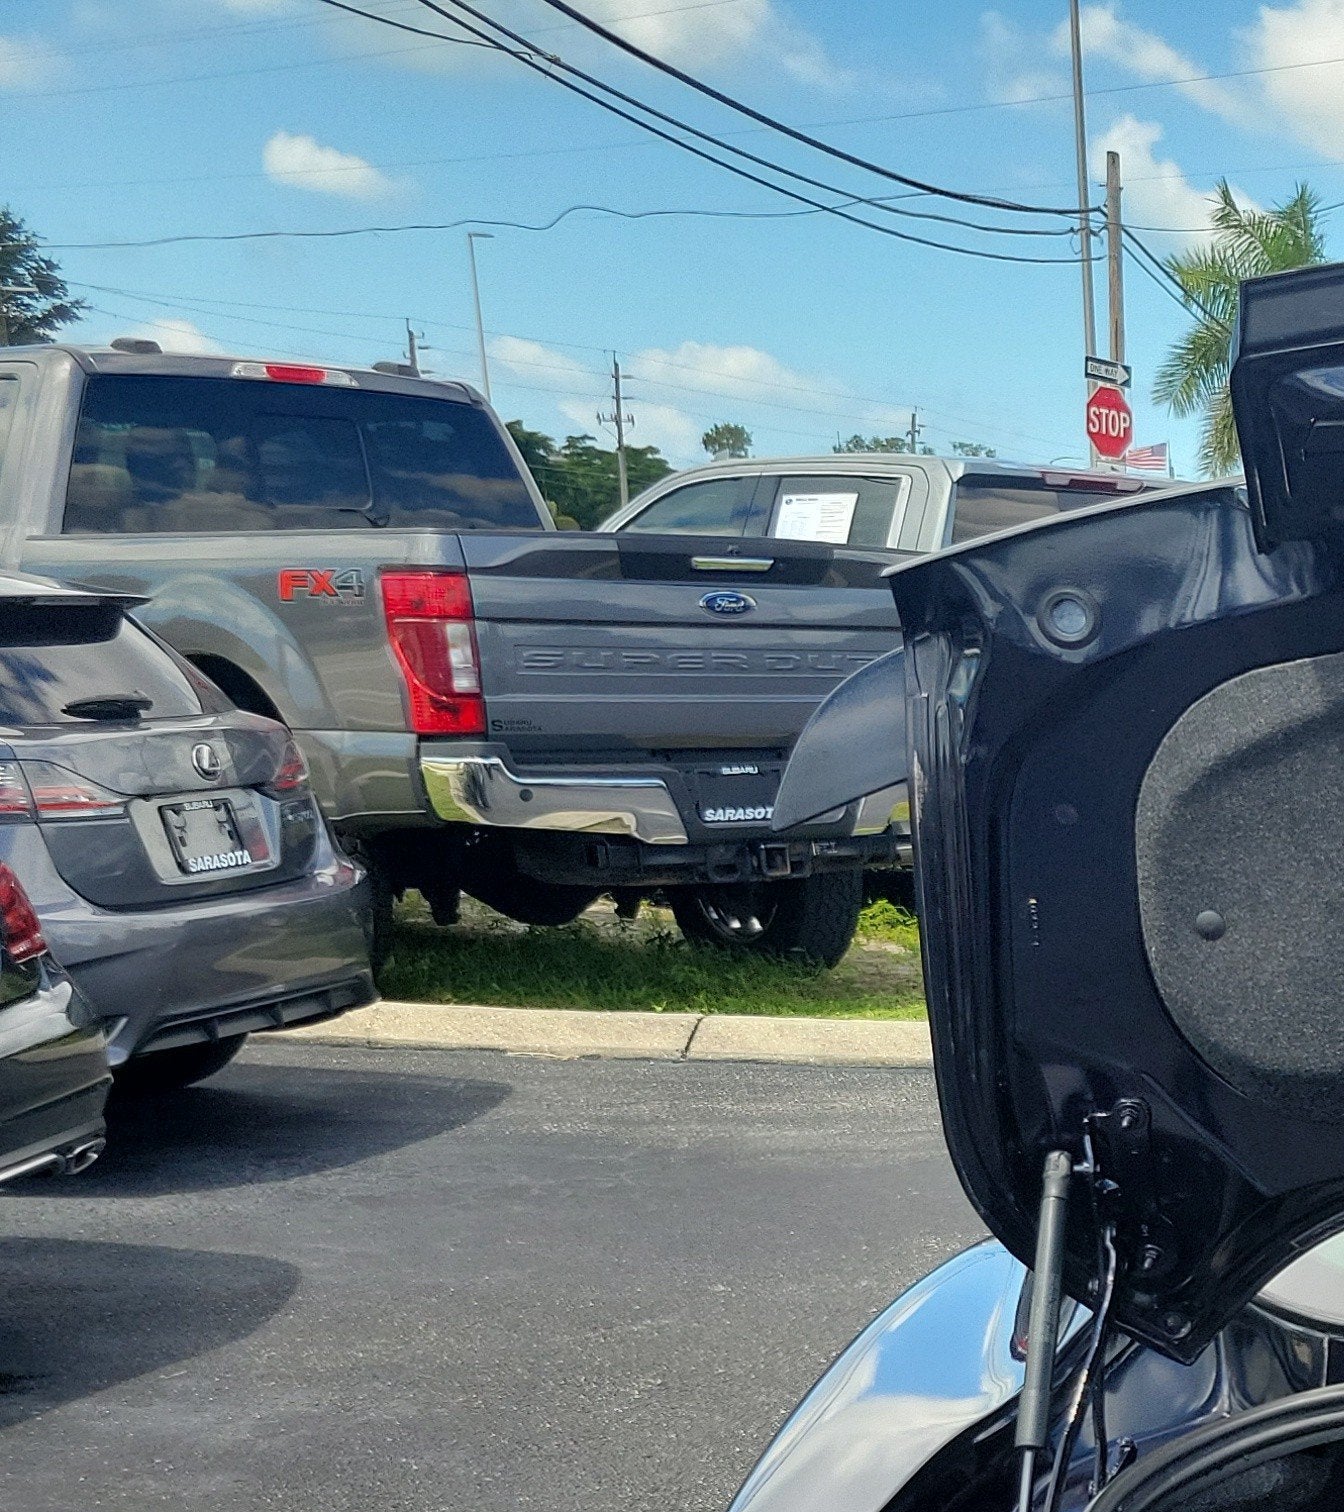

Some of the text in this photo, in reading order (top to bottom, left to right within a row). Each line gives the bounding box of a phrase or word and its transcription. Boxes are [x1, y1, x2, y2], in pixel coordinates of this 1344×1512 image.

[1089, 363, 1118, 378] ONE WAY
[1089, 407, 1131, 438] STOP
[278, 568, 365, 603] FX4
[714, 596, 746, 612] Ford
[522, 651, 749, 670] SUPER
[704, 807, 774, 821] SARASOT
[188, 850, 252, 872] SARASOTA
